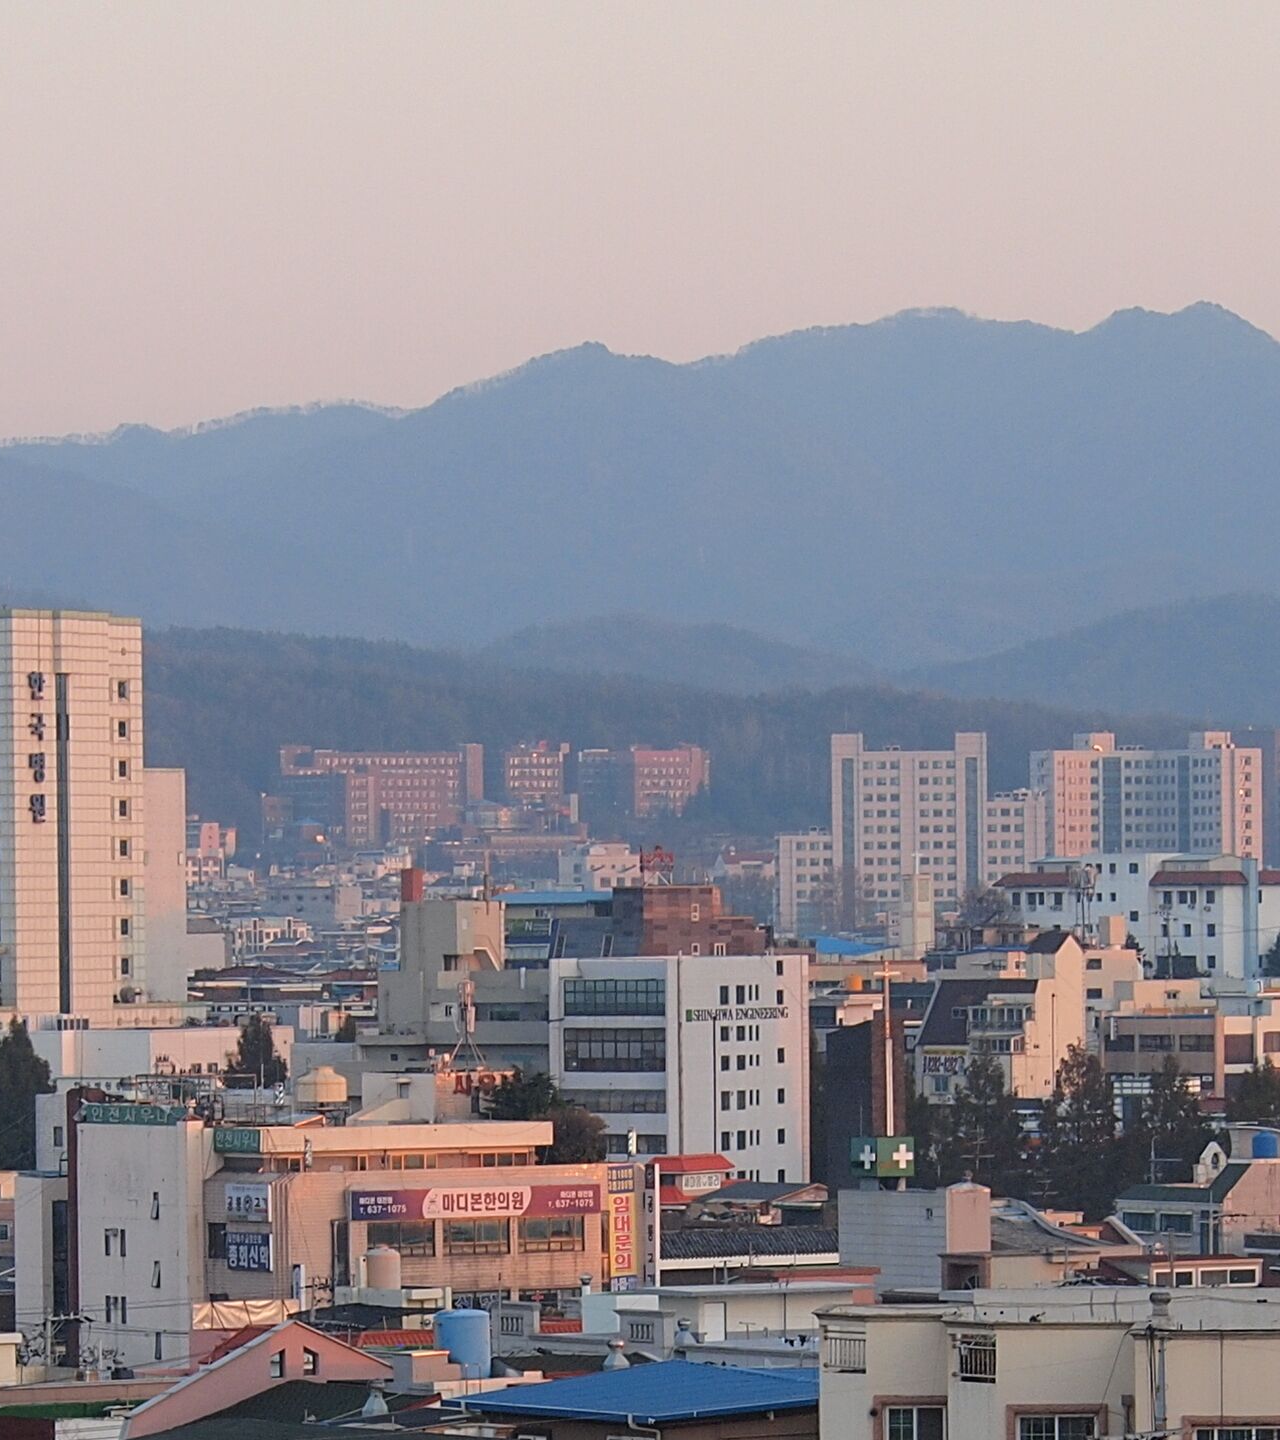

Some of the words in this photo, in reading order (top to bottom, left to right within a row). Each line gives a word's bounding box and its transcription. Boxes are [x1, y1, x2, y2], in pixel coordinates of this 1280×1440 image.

[28, 671, 47, 824] 한국병원
[735, 1006, 789, 1020] ENGINEERING
[367, 1205, 407, 1215] 637-1075
[442, 1192, 524, 1212] 마디본한의원
[555, 1199, 594, 1209] 637-1075
[613, 1196, 632, 1272] 임대문의
